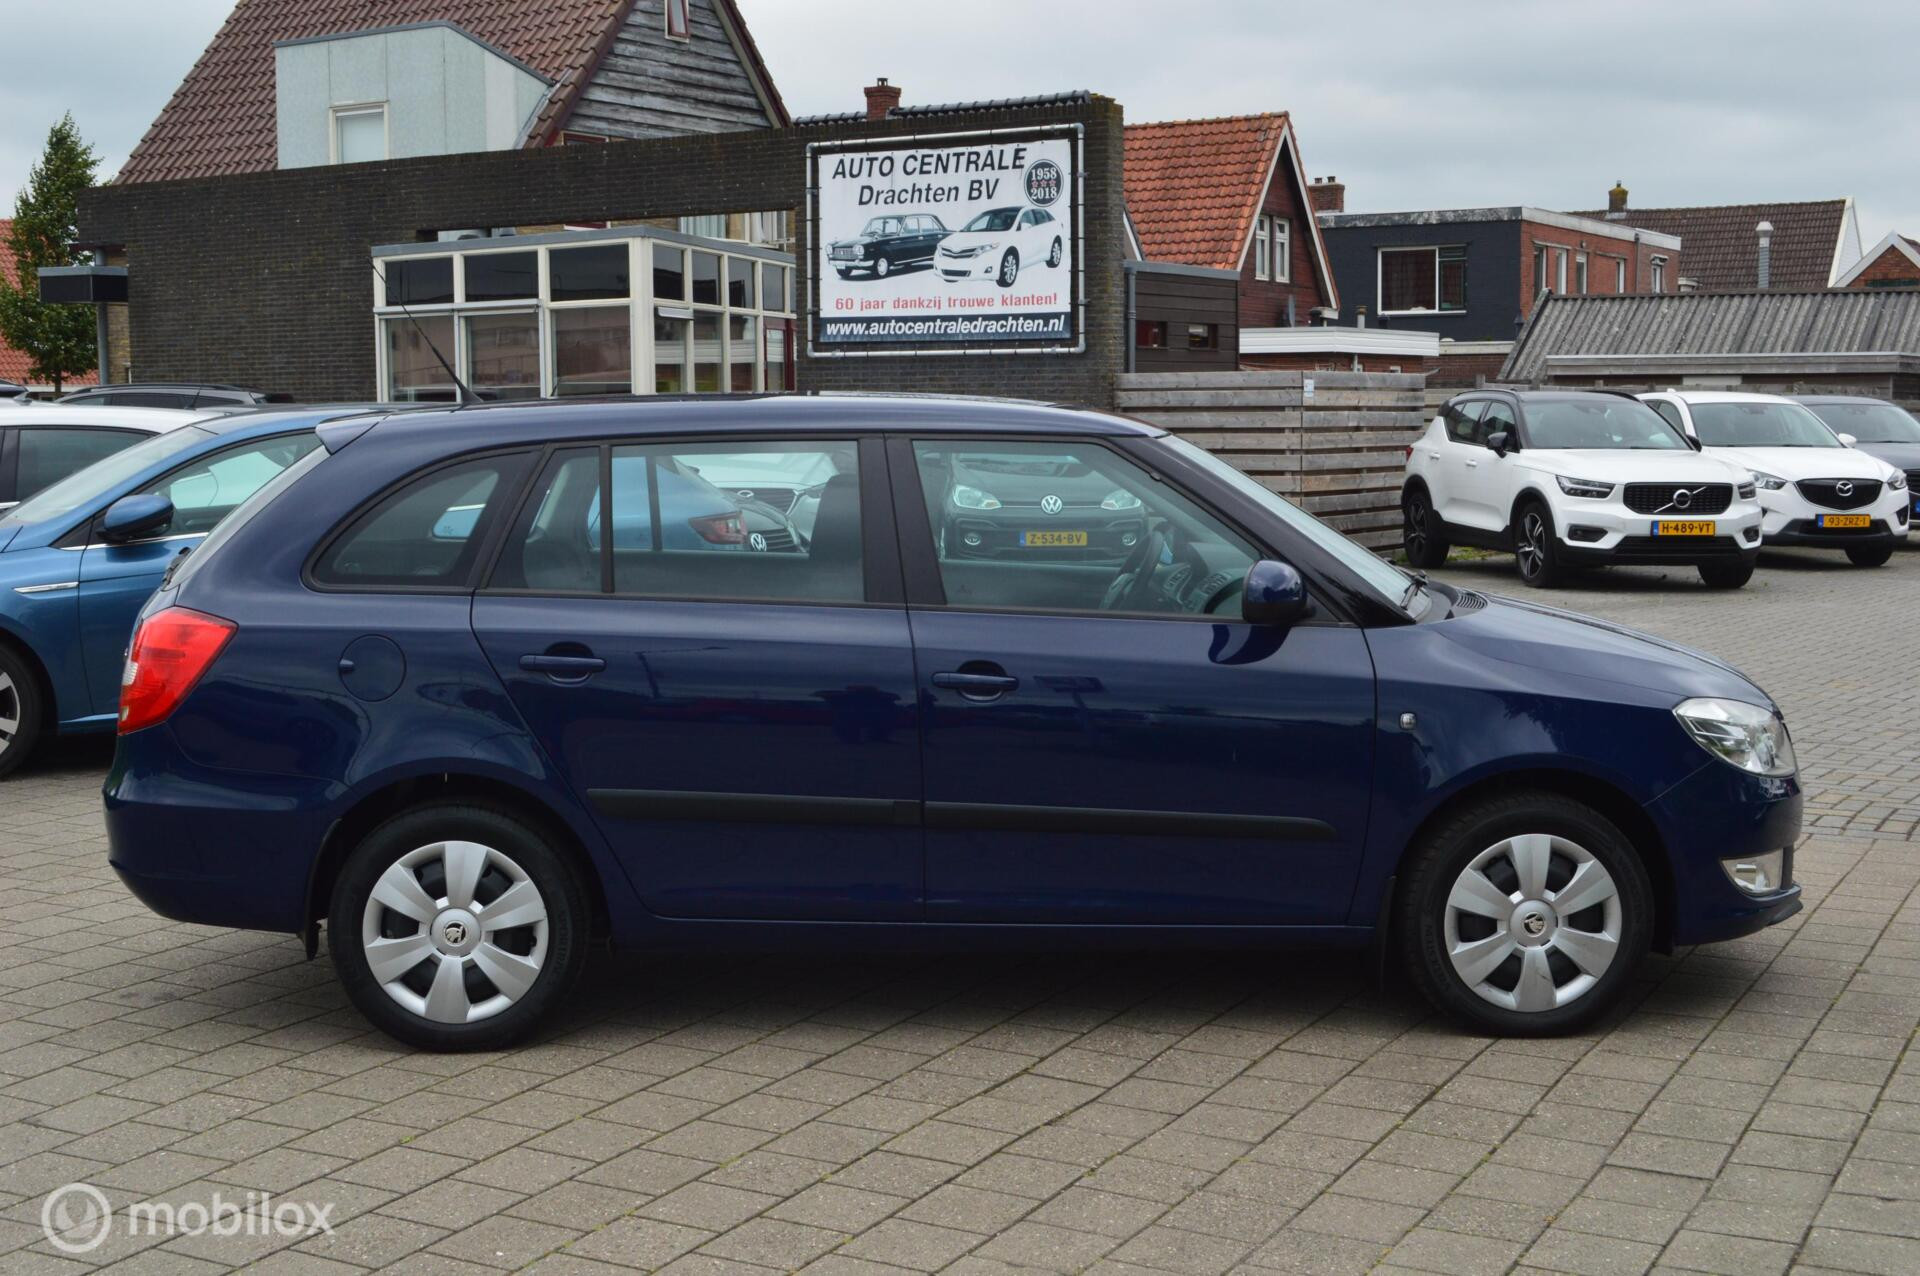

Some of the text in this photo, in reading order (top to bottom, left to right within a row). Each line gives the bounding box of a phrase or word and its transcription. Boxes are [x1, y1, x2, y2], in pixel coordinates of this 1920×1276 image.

[832, 148, 1027, 179] AUTO CENTRALE
[1030, 167, 1057, 180] 1958
[858, 178, 1000, 206] Drachten BV
[1030, 186, 1058, 200] 2018
[835, 293, 1058, 311] 60 jaar dankzij trouwe klanten!
[826, 315, 1065, 335] www.autocentraledrachten.nl
[1662, 522, 1712, 534] H-489-VT
[1030, 533, 1082, 545] Z-534-BV
